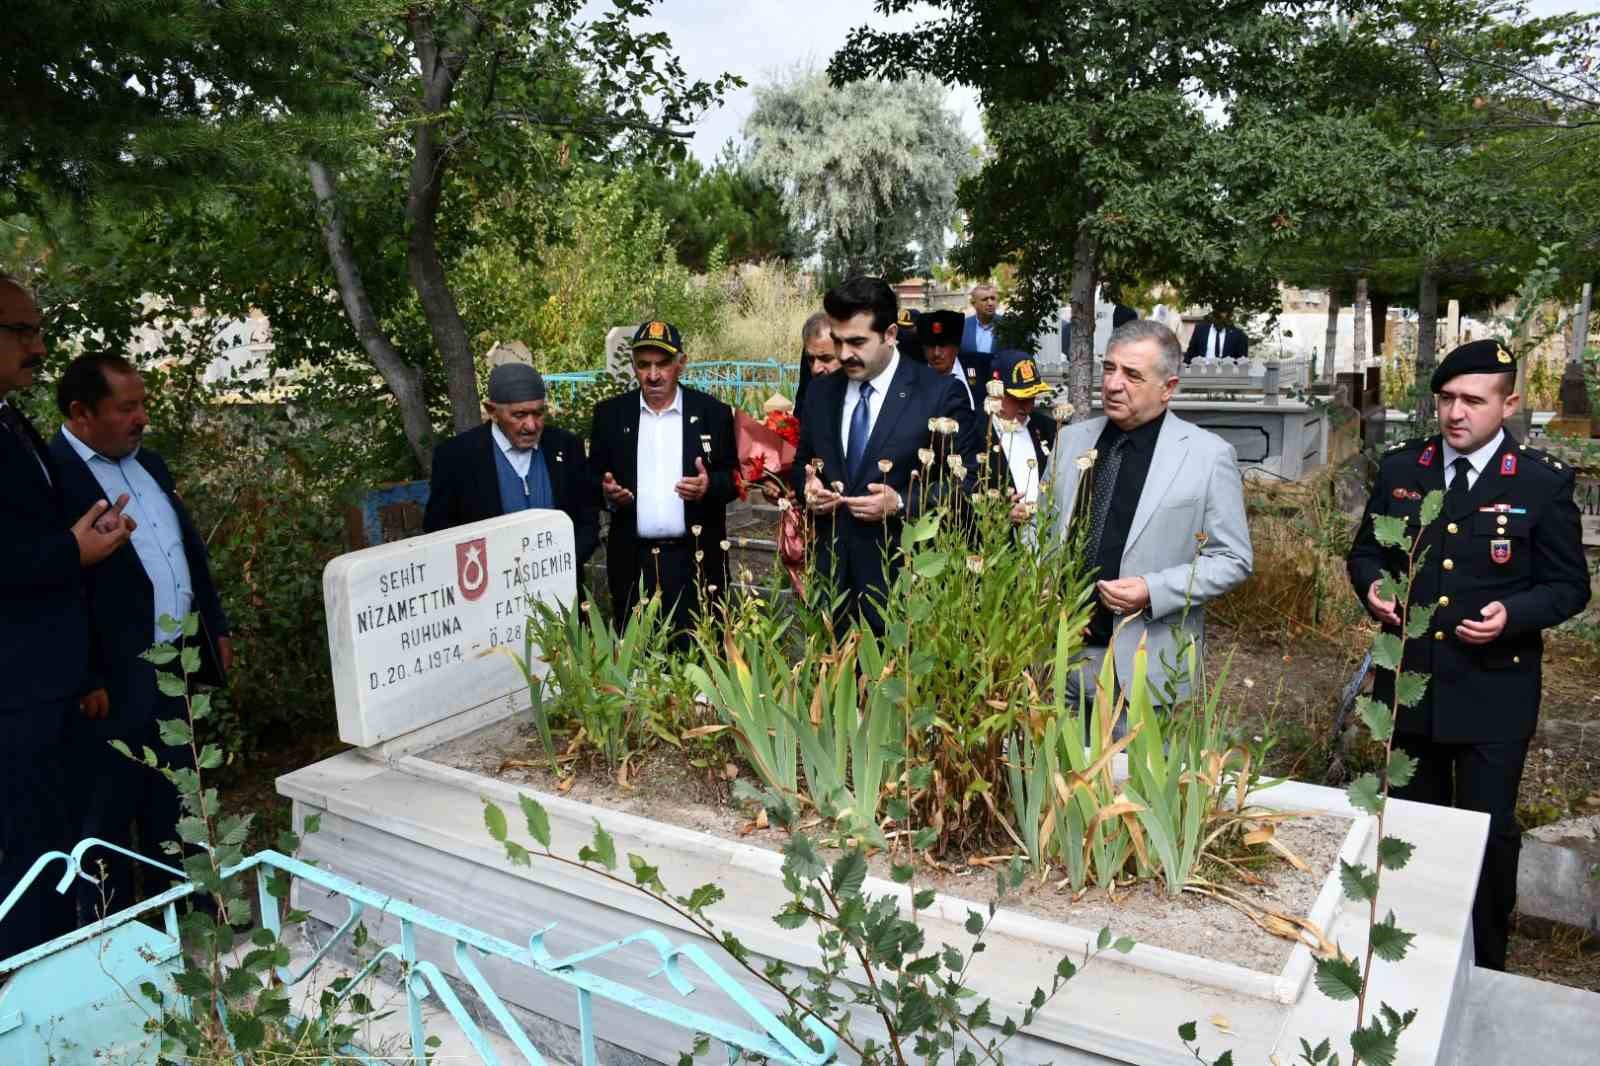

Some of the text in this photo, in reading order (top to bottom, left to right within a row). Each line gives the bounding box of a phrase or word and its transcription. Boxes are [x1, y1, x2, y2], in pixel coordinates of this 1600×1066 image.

[379, 562, 426, 598] ŞEHİT
[357, 584, 456, 634] NİZAMETTİN
[401, 615, 463, 651] RUHUNA
